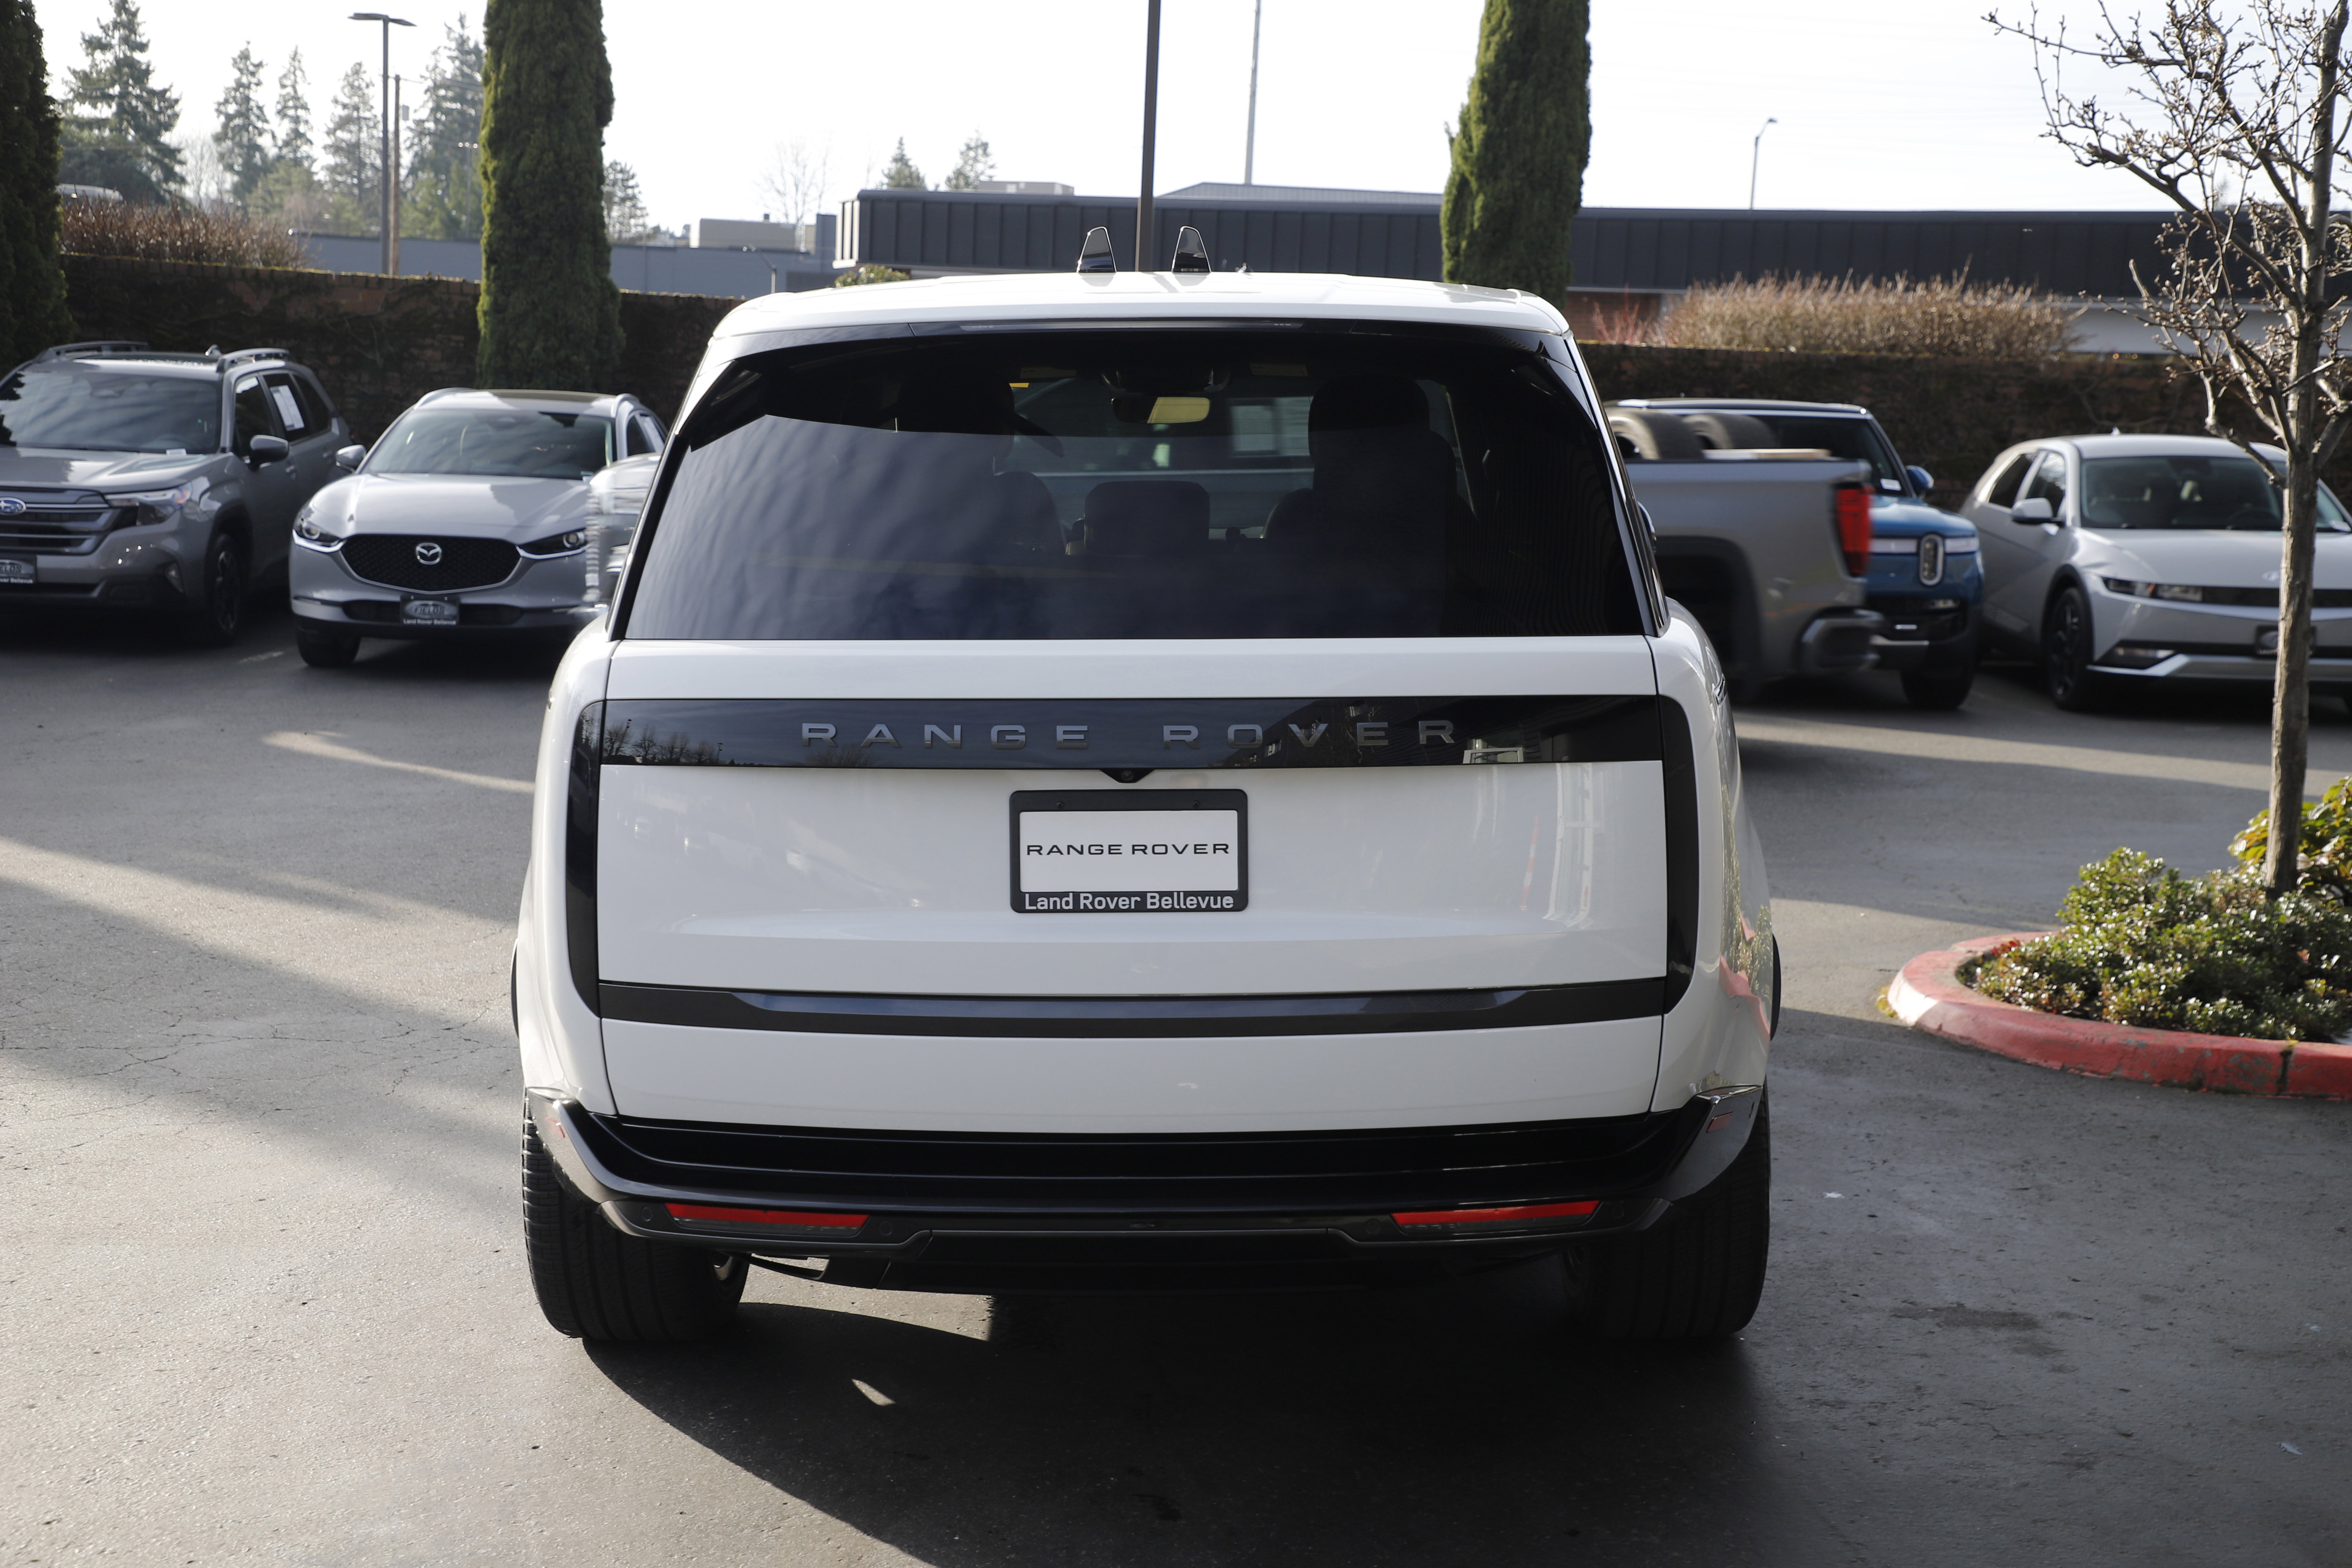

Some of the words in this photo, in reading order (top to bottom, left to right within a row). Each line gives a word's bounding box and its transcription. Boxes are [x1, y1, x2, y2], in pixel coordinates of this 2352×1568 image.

[802, 722, 1089, 750] RANGE
[1163, 720, 1455, 749] ROVER
[1027, 844, 1123, 855] RANGE
[1131, 843, 1229, 855] ROVER
[1025, 892, 1073, 910] Land
[1080, 893, 1141, 910] Rover
[1147, 891, 1234, 909] Bellevue
